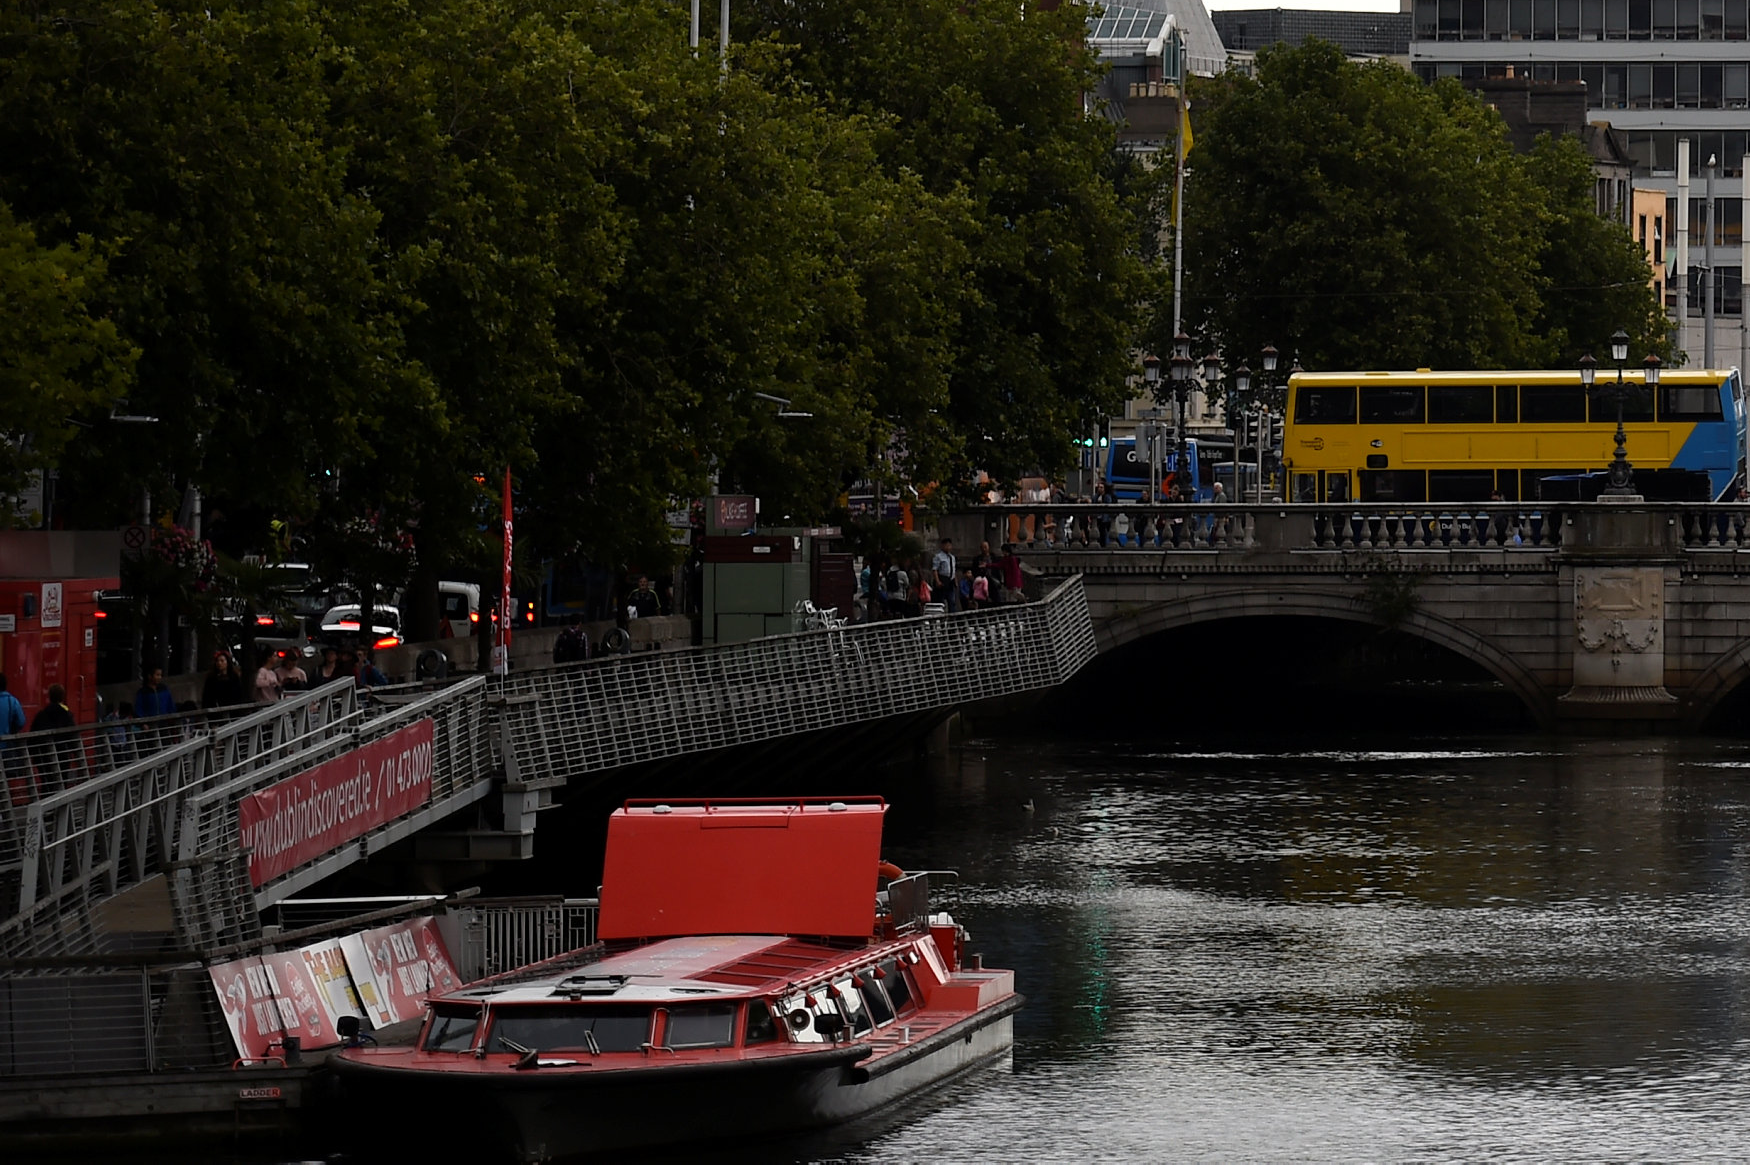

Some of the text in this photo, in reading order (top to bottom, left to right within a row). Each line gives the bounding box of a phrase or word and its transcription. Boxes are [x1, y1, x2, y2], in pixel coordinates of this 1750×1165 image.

[387, 758, 395, 799] 01
[397, 749, 411, 793] 473
[241, 1088, 279, 1097] LADDER
